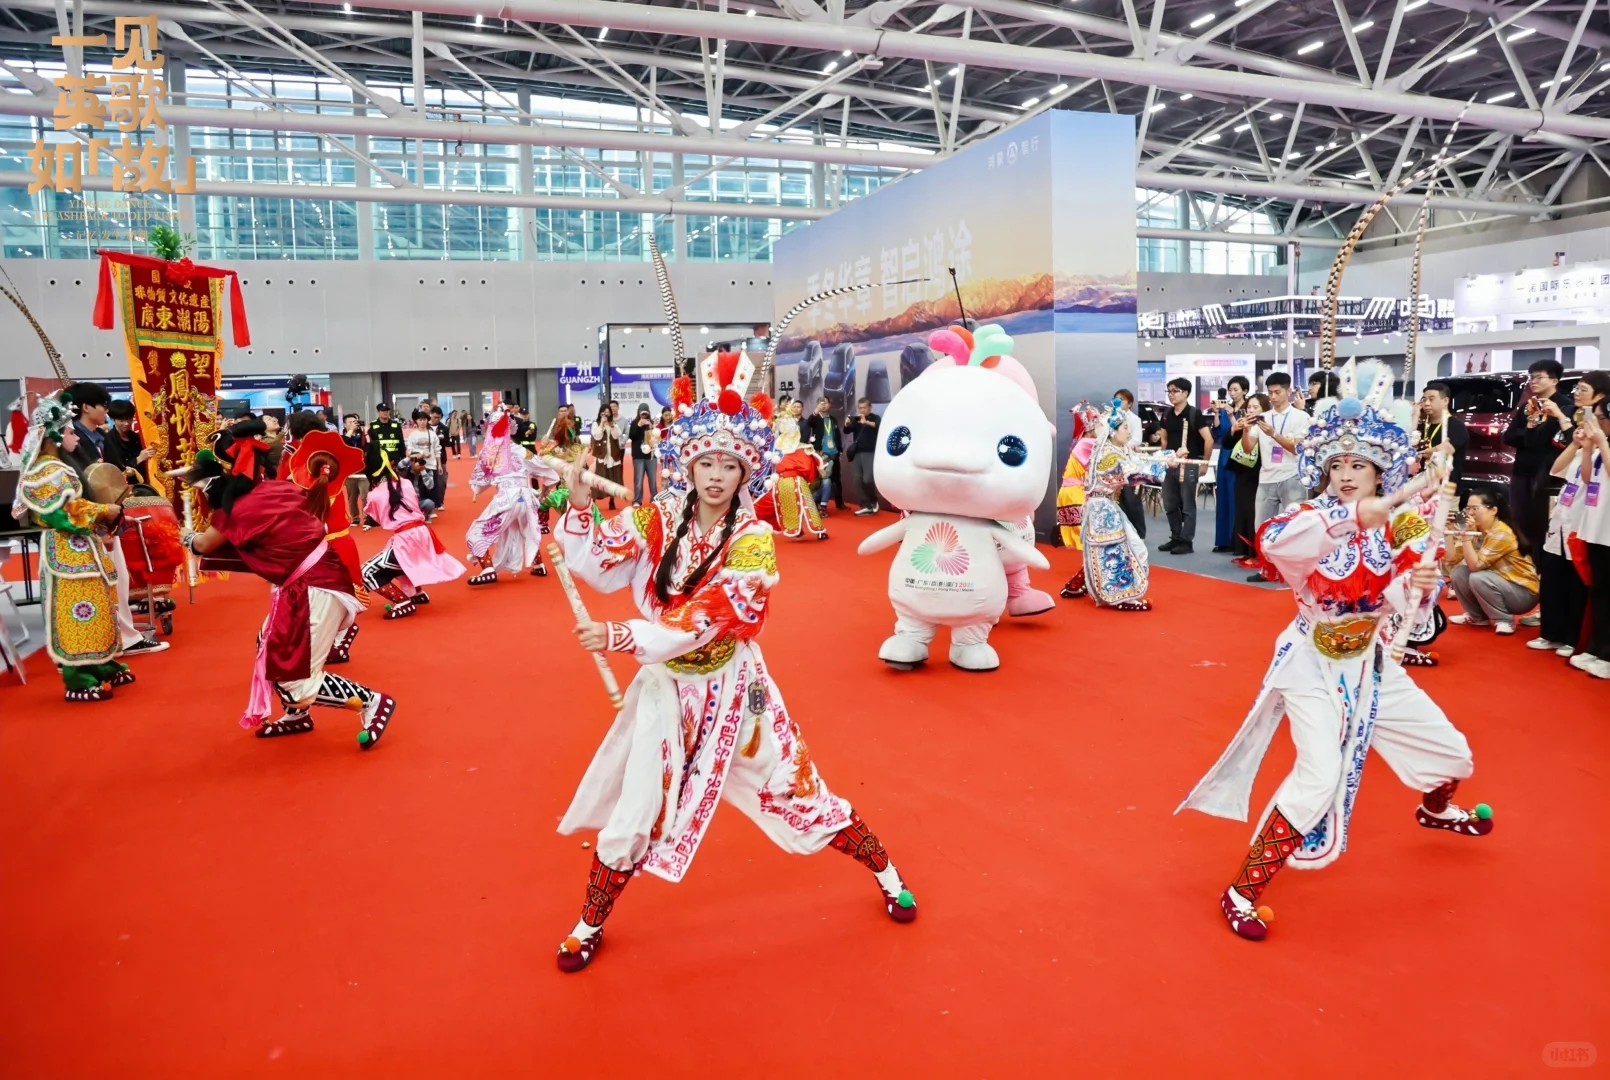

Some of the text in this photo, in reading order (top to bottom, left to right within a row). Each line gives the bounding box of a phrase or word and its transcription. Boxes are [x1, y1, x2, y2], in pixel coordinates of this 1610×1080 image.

[141, 302, 211, 334] 廣東潮陽
[561, 361, 592, 377] 广州
[560, 375, 612, 384] GUANGZH
